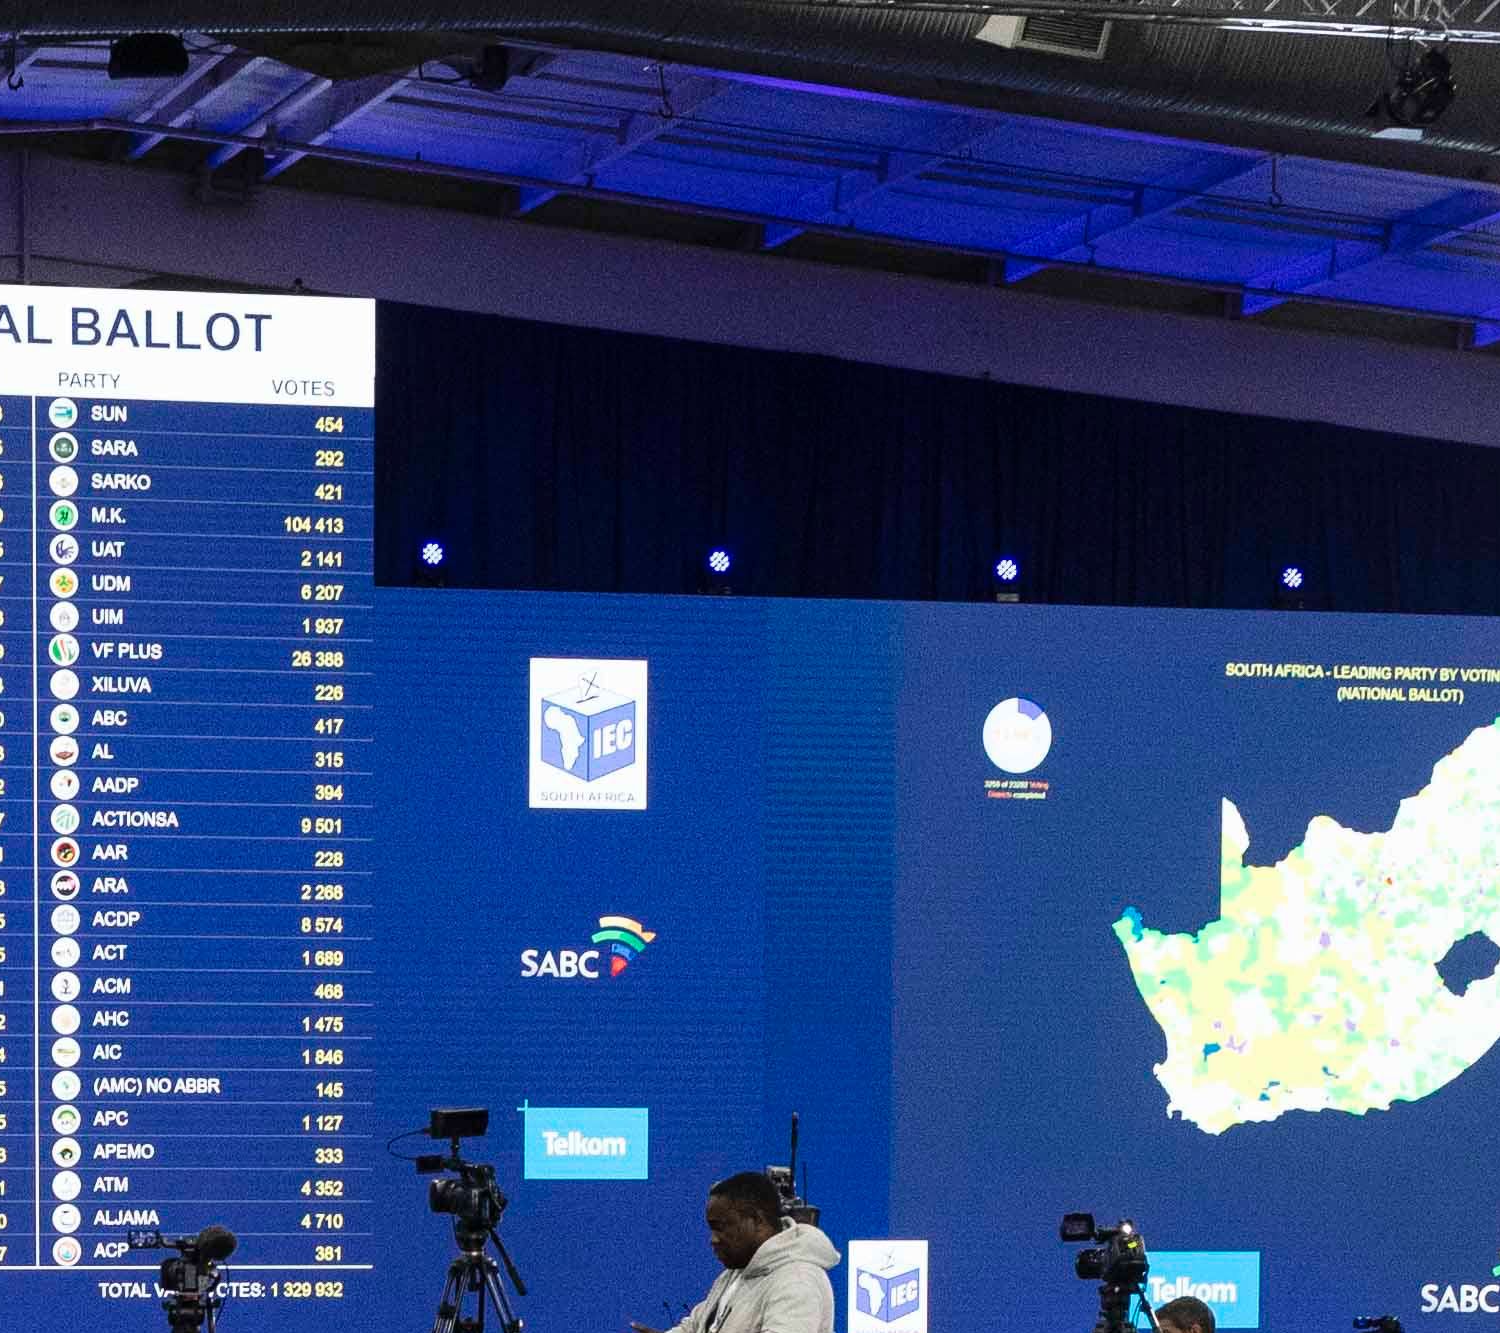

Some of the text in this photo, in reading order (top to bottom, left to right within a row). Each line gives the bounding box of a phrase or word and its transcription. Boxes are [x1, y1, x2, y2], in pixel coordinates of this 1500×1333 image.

[72, 308, 272, 351] BALLOT
[59, 372, 120, 388] PARTY
[272, 380, 334, 396] VOTES
[92, 405, 127, 422] SUN
[316, 417, 343, 432] 454
[92, 440, 138, 456] SARA
[92, 473, 151, 490] SARKO
[315, 485, 341, 500] 421
[92, 507, 125, 523] M.K.
[93, 575, 130, 591] UDM
[92, 643, 162, 659] VF PLUS
[1226, 663, 1272, 676] SOUTH
[1274, 664, 1324, 678] AFRICA
[1334, 666, 1392, 680] LEADING
[1395, 667, 1437, 680] PARTY
[1440, 668, 1458, 681] BY
[92, 677, 151, 692] XILUVA
[1337, 687, 1464, 704] (NATIONAL BALLOT)
[92, 710, 127, 726] ABC
[315, 719, 343, 733] 417
[593, 719, 632, 760] IEC
[92, 777, 138, 792] AADP
[315, 785, 343, 800] 394
[541, 792, 584, 801] SOUTH
[92, 811, 178, 827] ACTIONSA
[93, 845, 127, 859] AAR
[93, 911, 140, 926] ACDP
[522, 950, 599, 978] SABC
[93, 978, 130, 993] ACM
[93, 1011, 128, 1026] AHC
[94, 1078, 220, 1096] (AMC) NO ABBR
[543, 1131, 626, 1155] Telkom
[94, 1144, 154, 1159] APEMO
[94, 1177, 128, 1192] ATM
[94, 1210, 159, 1225] ALJAMA
[99, 1283, 156, 1297] TOTAL
[271, 1282, 279, 1297] 1
[284, 1282, 312, 1297] 329
[316, 1282, 344, 1297] 932
[890, 1282, 919, 1308] IEC
[1422, 1284, 1500, 1312] SABC
